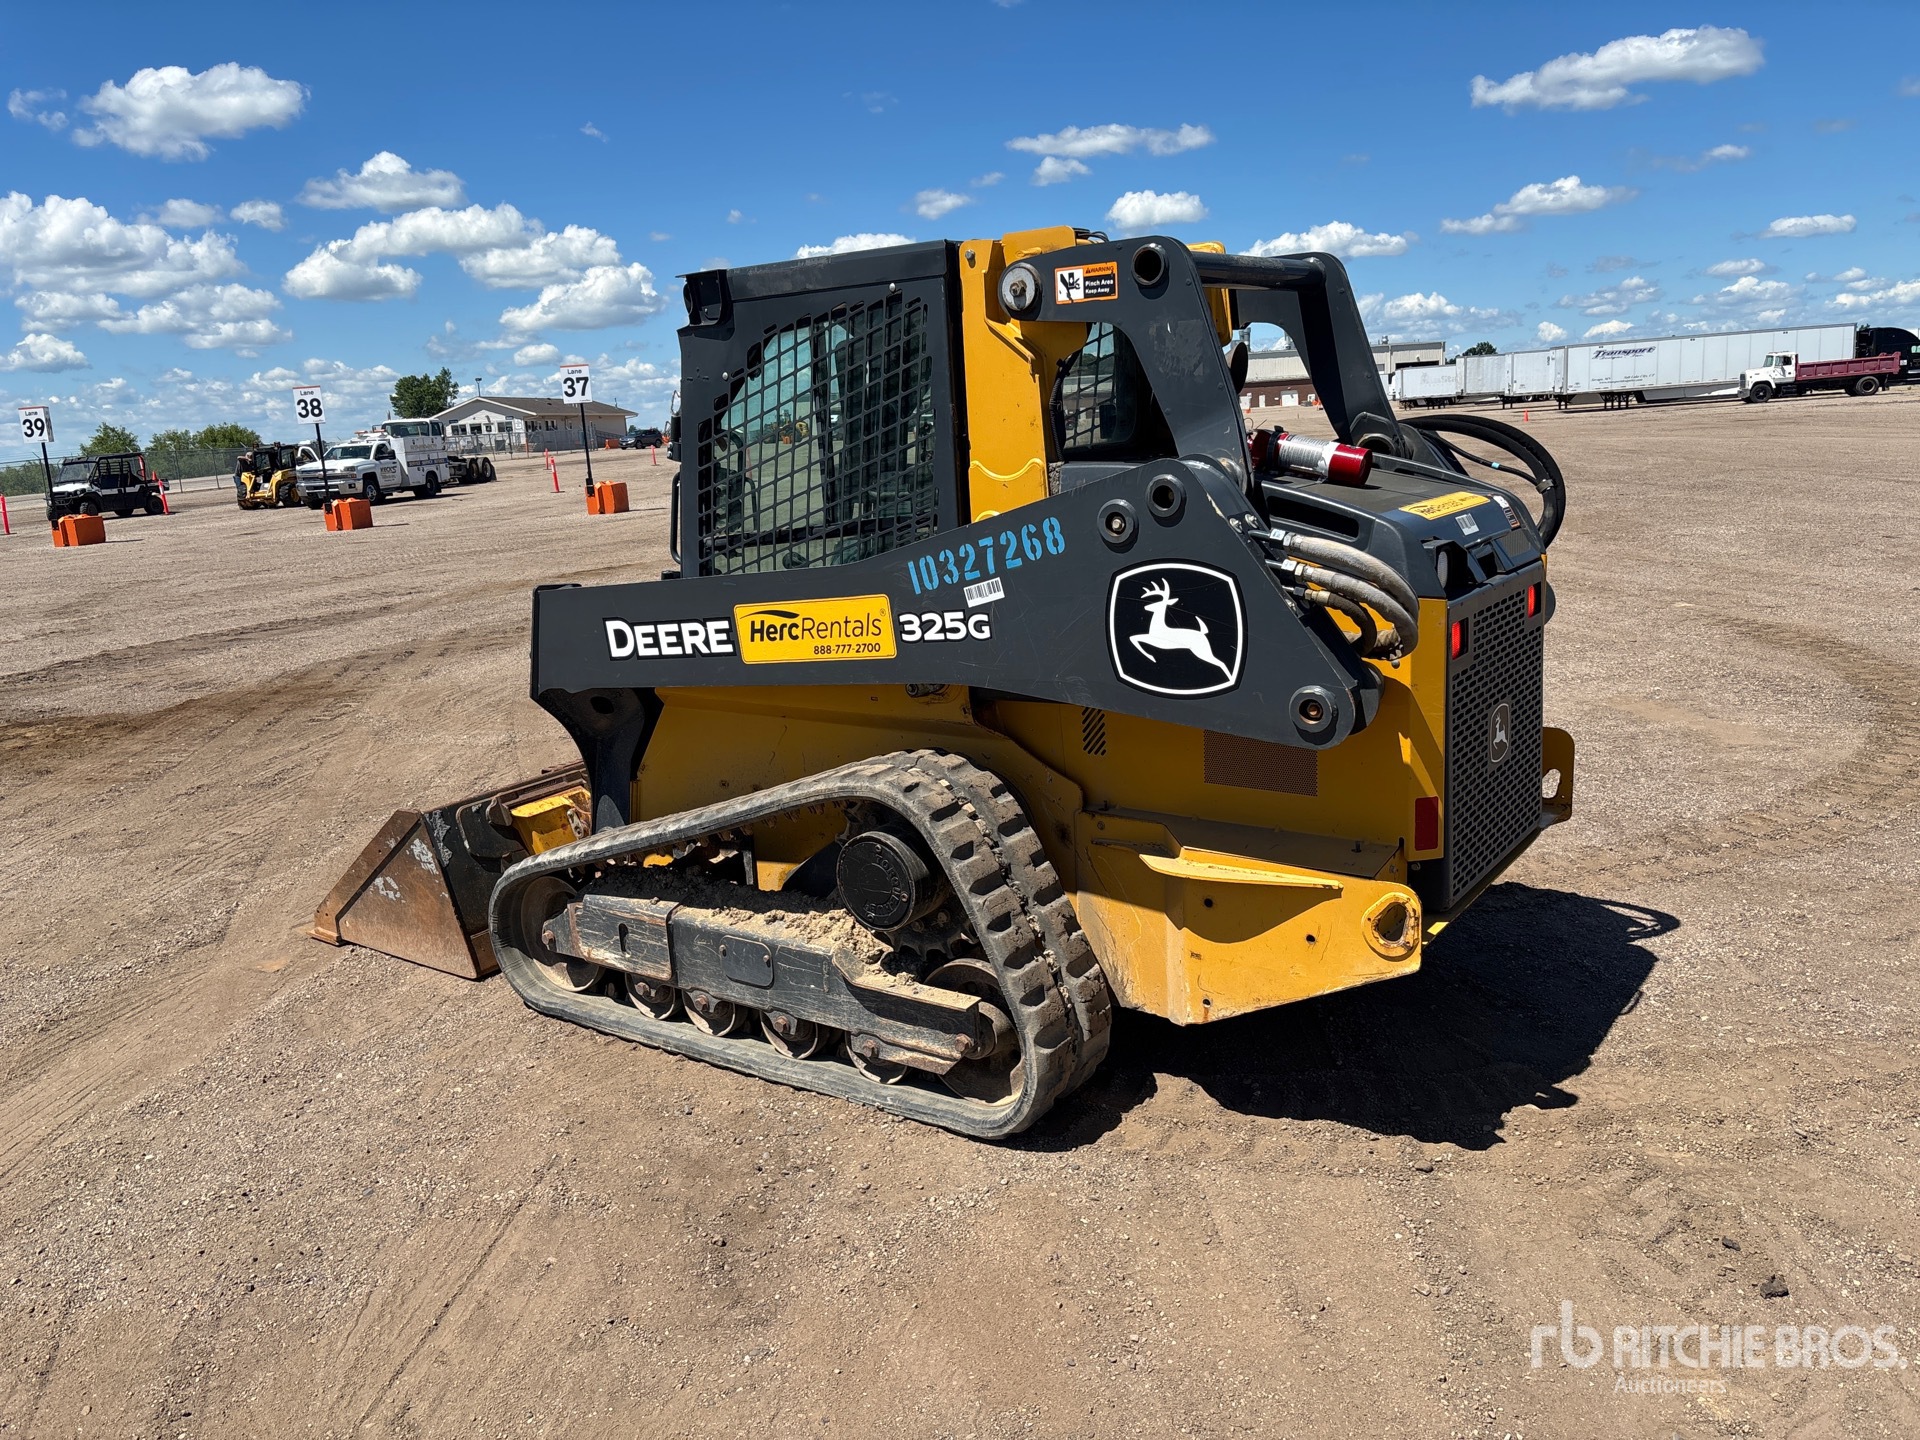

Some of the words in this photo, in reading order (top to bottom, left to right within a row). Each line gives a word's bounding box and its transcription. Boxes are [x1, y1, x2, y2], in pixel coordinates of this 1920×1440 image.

[1592, 346, 1656, 359] Transport
[563, 376, 589, 398] 37
[296, 398, 323, 418] 38
[22, 418, 45, 438] 39
[907, 516, 1066, 595] 10327268
[749, 612, 882, 642] HercRentals
[898, 611, 991, 642] 325G
[604, 619, 734, 658] DEERE
[813, 642, 881, 655] 888-777-2700
